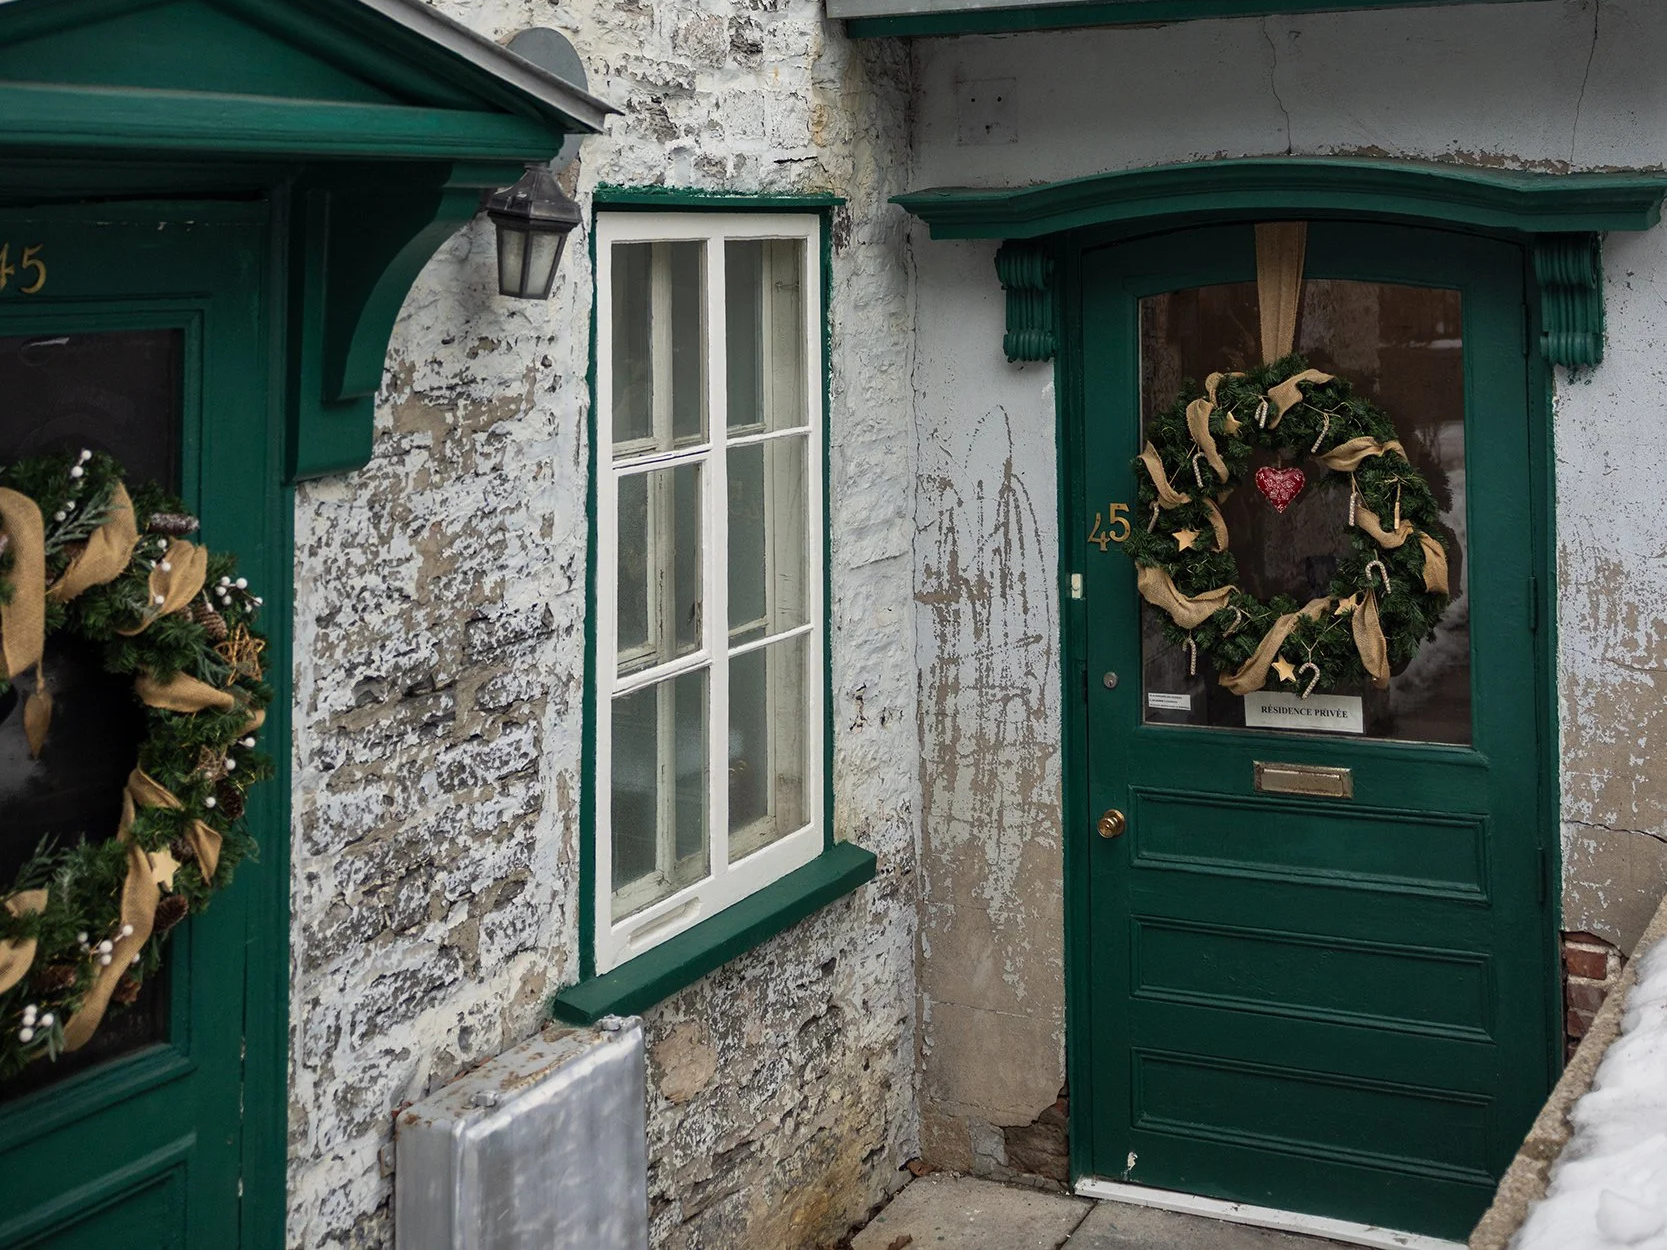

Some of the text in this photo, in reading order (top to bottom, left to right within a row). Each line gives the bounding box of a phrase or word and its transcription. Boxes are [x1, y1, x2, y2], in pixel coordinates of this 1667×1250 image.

[1088, 503, 1131, 551] 45
[1261, 704, 1348, 719] RÉSIDENCE PRIVÉE
